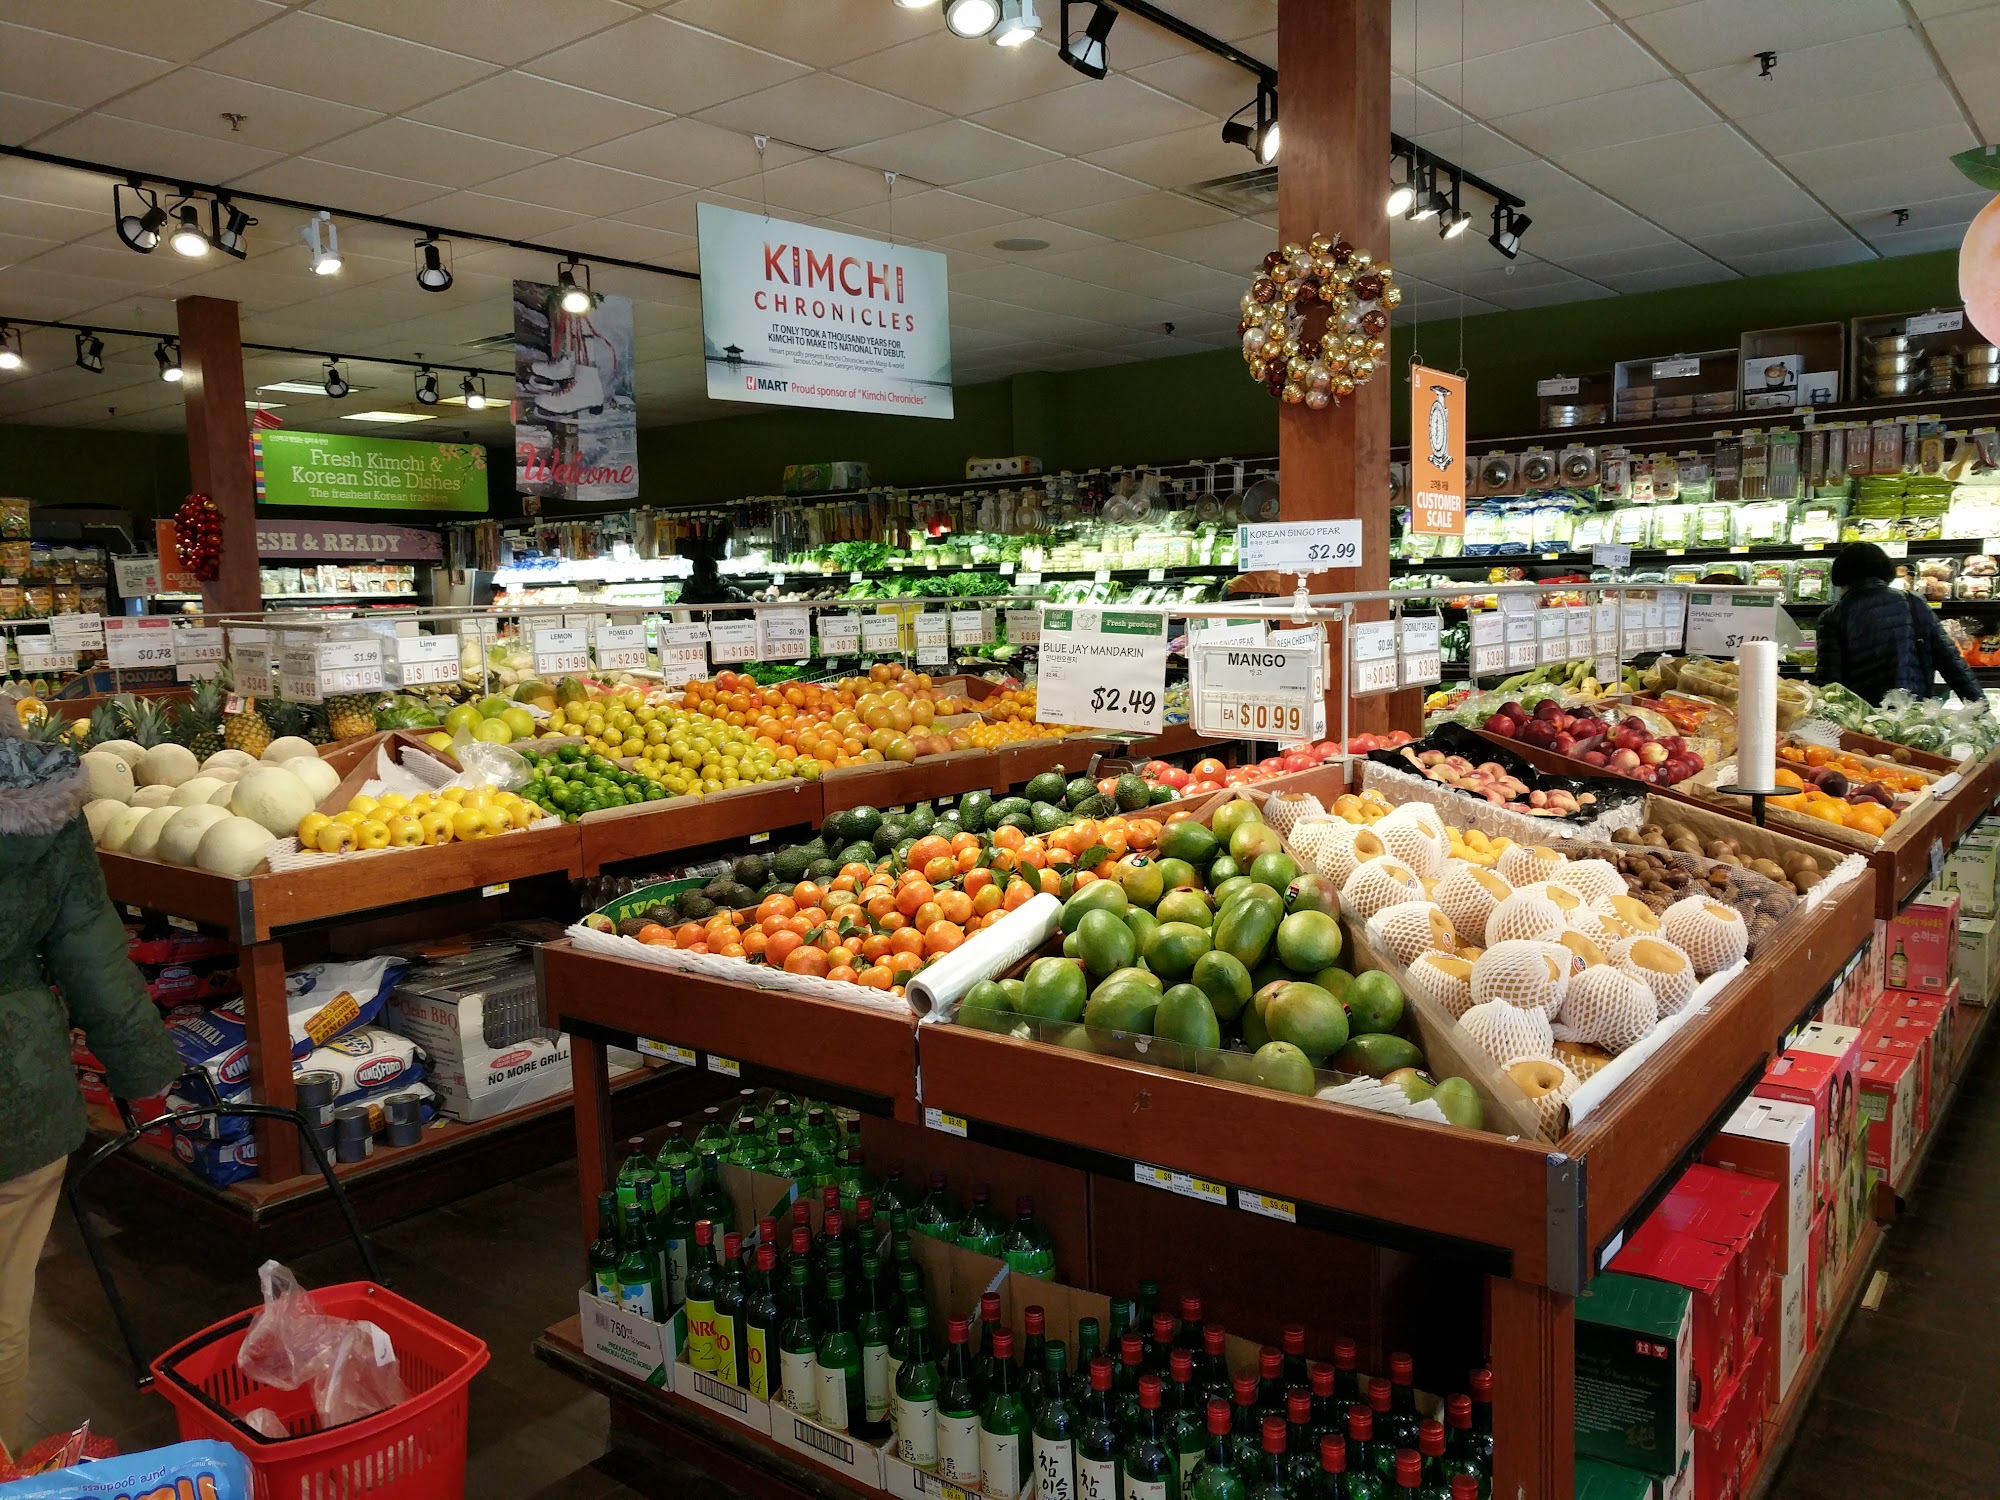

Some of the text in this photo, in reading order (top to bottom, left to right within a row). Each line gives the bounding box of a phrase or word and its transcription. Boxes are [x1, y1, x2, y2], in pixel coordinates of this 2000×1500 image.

[763, 241, 904, 304] KIMCHI
[754, 290, 915, 332] CHRONICLES
[772, 323, 901, 349] IT ONLY TOOK A THOUSAND YEARS FOR
[768, 333, 906, 359] KIMCHI TO MAKE ITS NATIONAL TV DEBUT.
[786, 349, 804, 359] proudly
[758, 378, 788, 392] MART
[791, 382, 816, 396] Proud
[817, 386, 848, 400] sponsor
[849, 387, 857, 399] of
[311, 448, 443, 473] Fresh Kimchi &
[519, 442, 635, 484] Welcome
[292, 466, 461, 491] Korean Side Dishes
[308, 487, 448, 504] The freshest Korean tradition
[1416, 491, 1462, 512] CUSTOMER
[1426, 510, 1452, 528] SCALE
[1250, 530, 1286, 540] KOREAN
[1287, 528, 1316, 538] SINGO
[1316, 527, 1341, 536] PEAR
[302, 533, 401, 552] & READY
[1308, 543, 1356, 562] $2.99
[79, 621, 99, 629] $0.99
[608, 629, 634, 637] POMELO
[1106, 619, 1157, 631] Fresh produce
[1421, 622, 1436, 631] PEACH
[420, 640, 437, 648] Lime
[689, 631, 708, 640] $0.99
[1043, 642, 1144, 658] BLUE JAY MANDARIN
[1378, 638, 1393, 651] $0.99
[138, 649, 172, 660] $0.78
[354, 652, 377, 662] $1.99
[541, 658, 546, 666] 3
[1228, 652, 1286, 668] MANGO
[689, 673, 706, 681] $1.99
[1091, 685, 1156, 715] $2.49
[1224, 709, 1234, 720] EA
[335, 1001, 354, 1018] GOING
[316, 1007, 359, 1043] LONGER
[322, 1017, 335, 1029] BBQ
[402, 1002, 460, 1036] Clean BBQ
[359, 1060, 401, 1081] KINGSFORD
[488, 1050, 569, 1086] NO MORE GRILL
[1201, 1183, 1220, 1195] $9.49
[1270, 1200, 1289, 1213] $9.49
[611, 1319, 626, 1339] 750
[140, 1466, 166, 1484] pure
[81, 1476, 135, 1492] goodness
